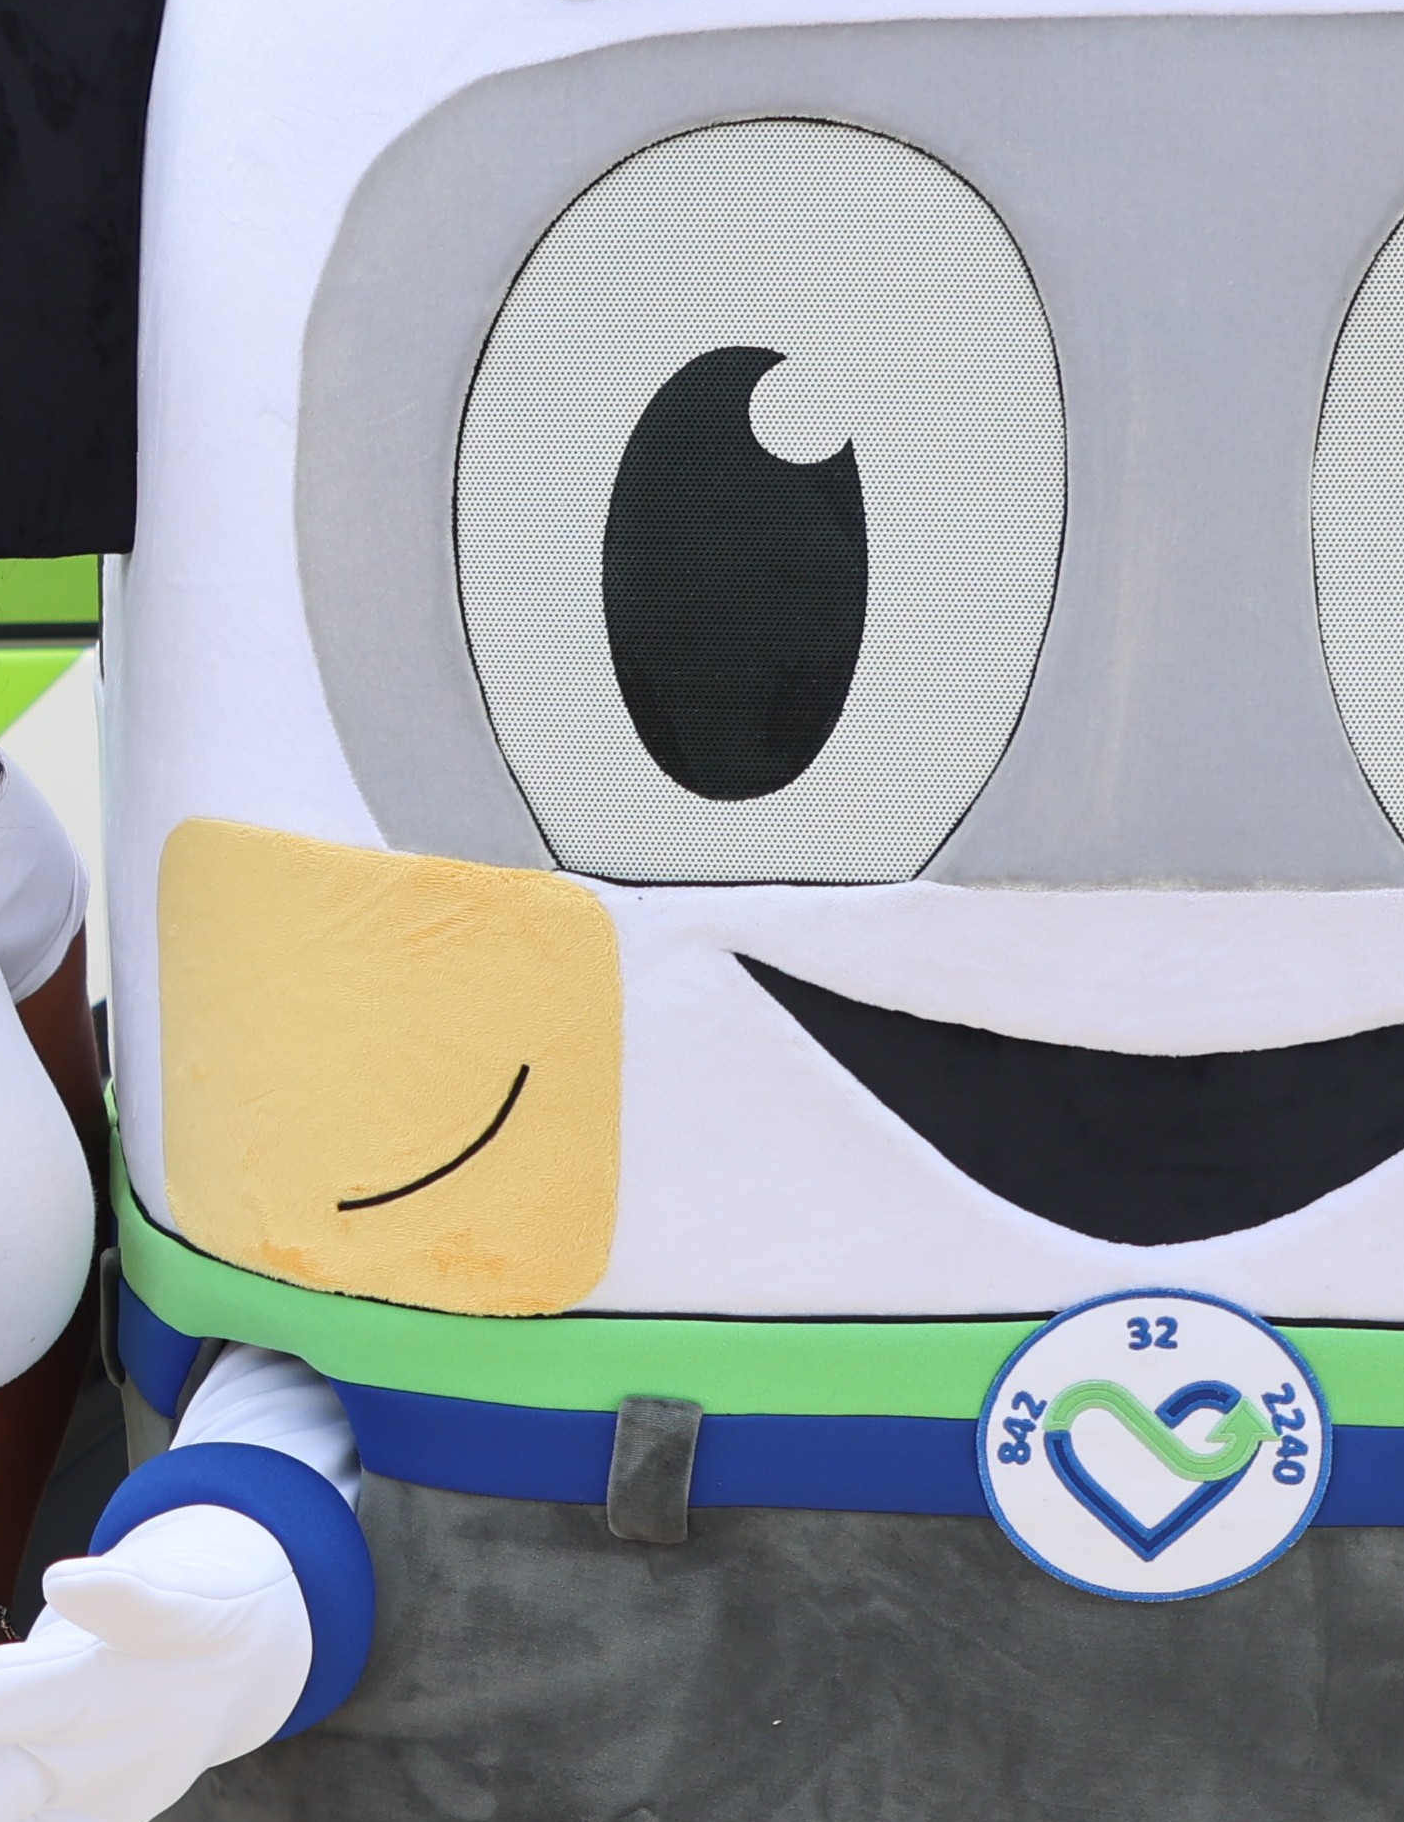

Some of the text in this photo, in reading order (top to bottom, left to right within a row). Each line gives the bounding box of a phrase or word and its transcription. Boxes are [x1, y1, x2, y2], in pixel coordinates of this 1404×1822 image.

[1126, 1315, 1179, 1351] 32
[997, 1390, 1049, 1466] 842
[1260, 1382, 1310, 1486] 2240
